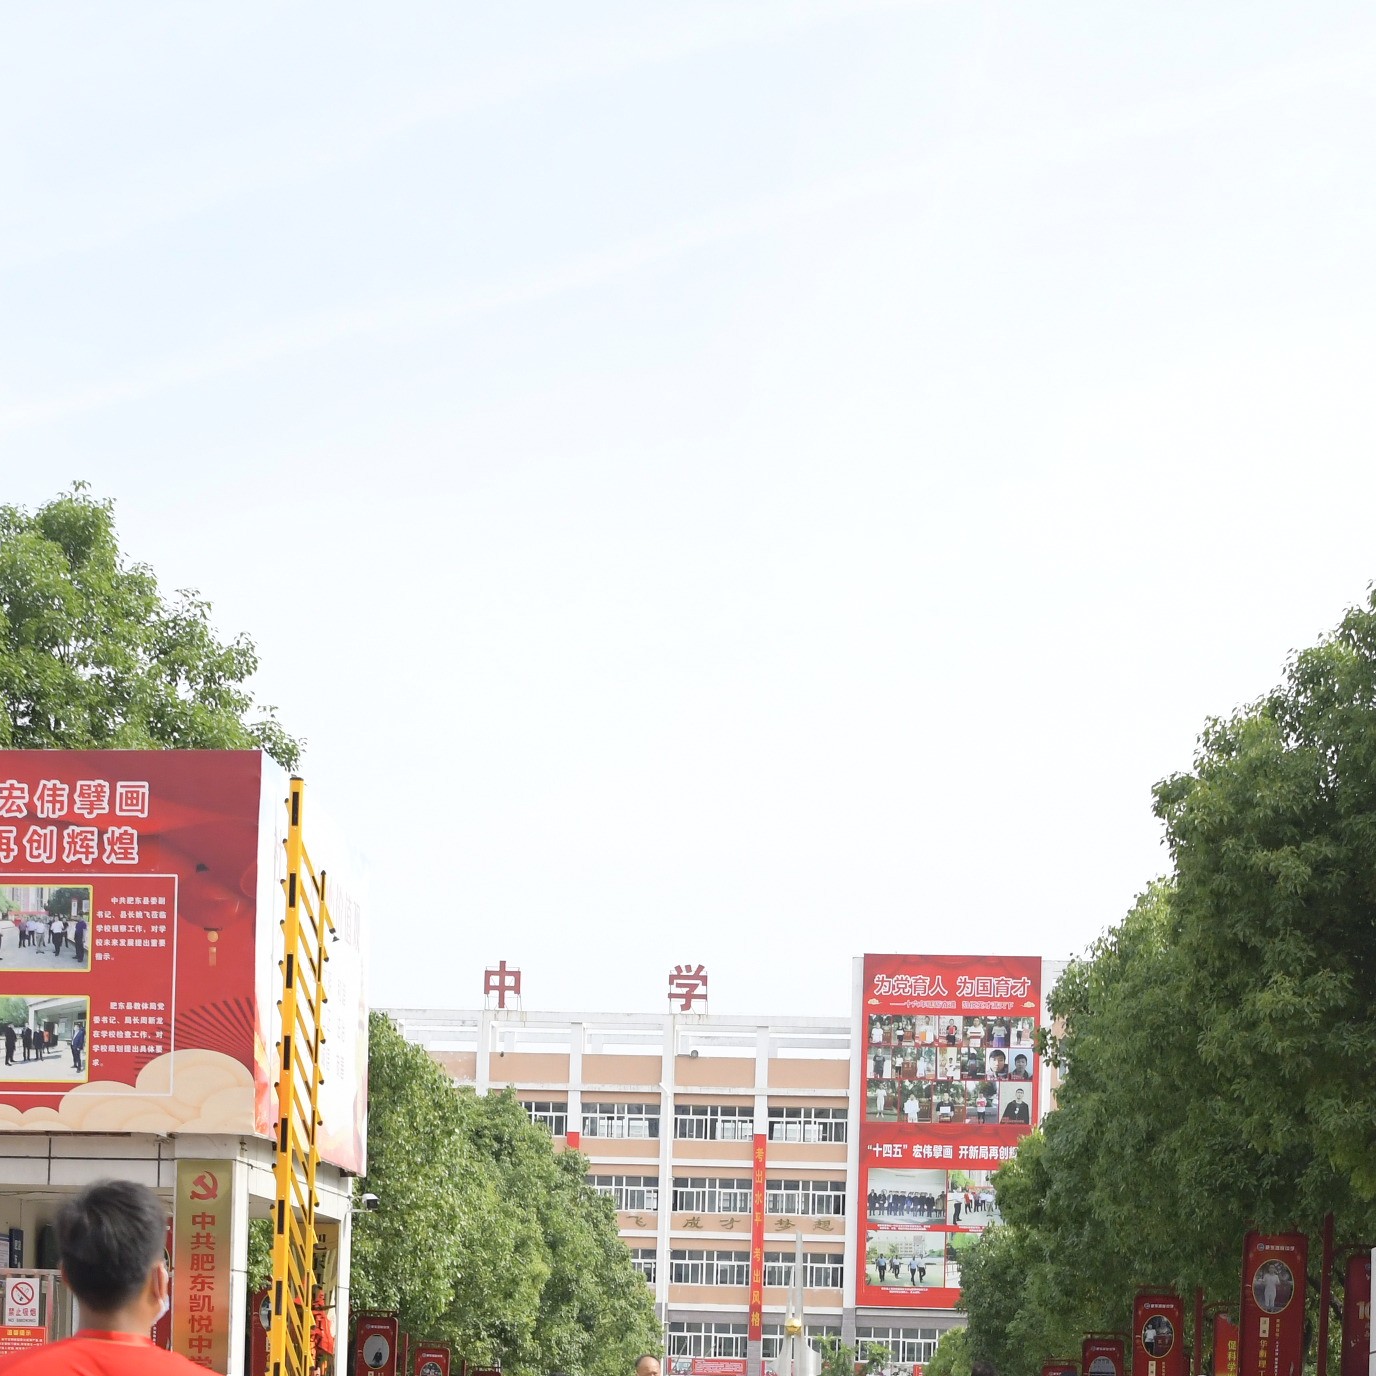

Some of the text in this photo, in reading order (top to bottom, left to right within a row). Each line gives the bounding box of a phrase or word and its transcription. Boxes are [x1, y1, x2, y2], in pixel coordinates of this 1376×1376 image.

[874, 975, 1031, 998] 为党育人 为国育才
[754, 1147, 764, 1228] 考出水平
[8, 1307, 36, 1317] 禁止吸烟
[751, 1247, 762, 1327] 考出风格
